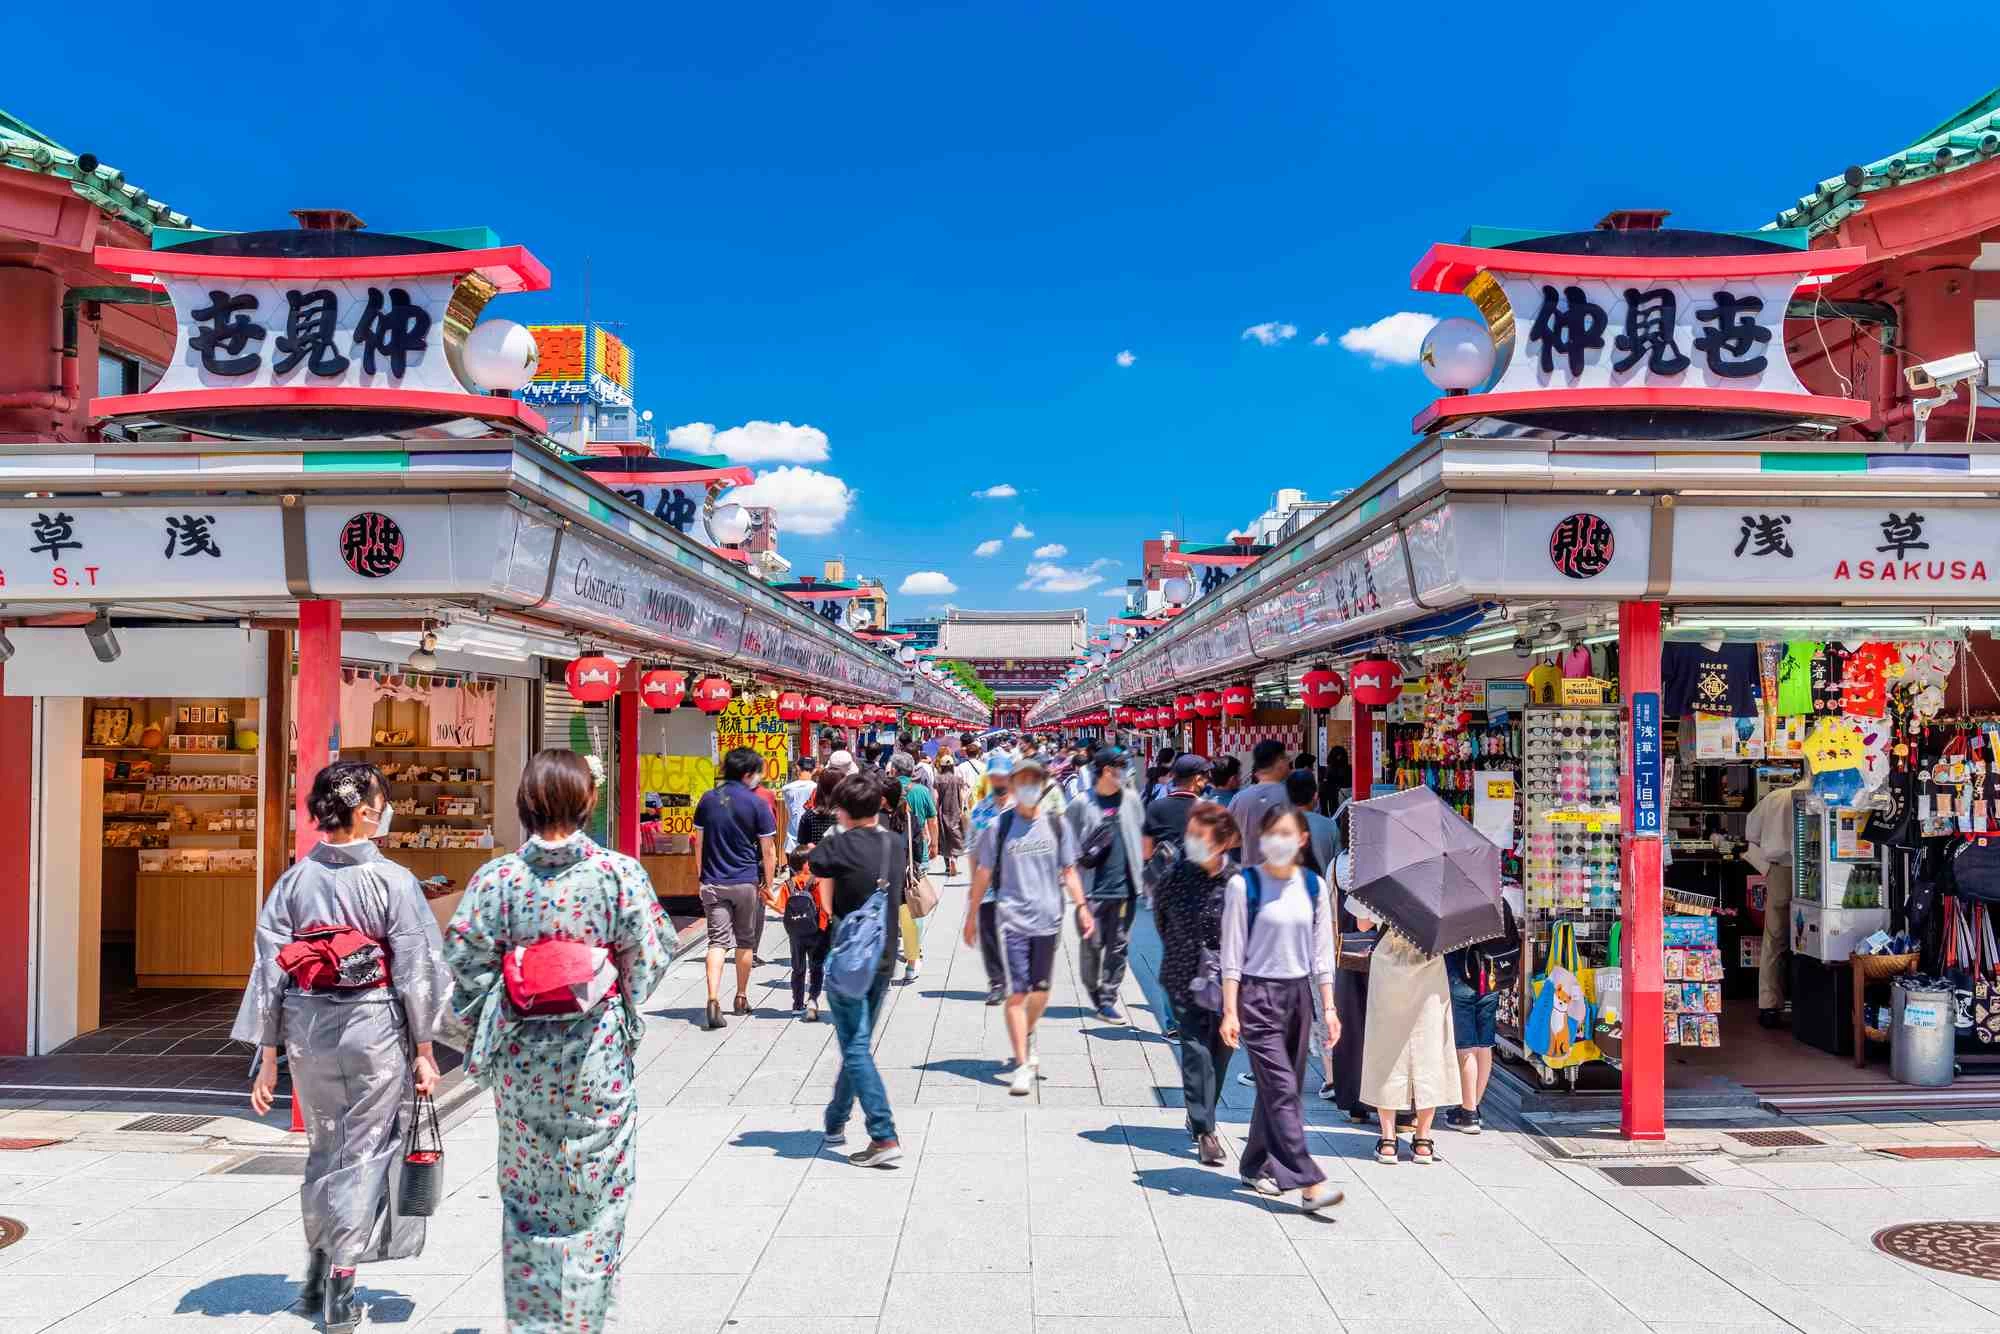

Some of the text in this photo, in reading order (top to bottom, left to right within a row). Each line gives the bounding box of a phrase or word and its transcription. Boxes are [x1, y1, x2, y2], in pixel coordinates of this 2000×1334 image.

[1529, 285, 1773, 379] 仲見世
[1734, 511, 1930, 560] 浅草
[52, 566, 100, 587] S.T
[574, 557, 627, 610] Cosmetics
[1834, 559, 1988, 581] ASAKUSA
[1641, 726, 1654, 801] 浅草一丁目
[663, 816, 693, 833] 300
[1640, 811, 1656, 827] 18
